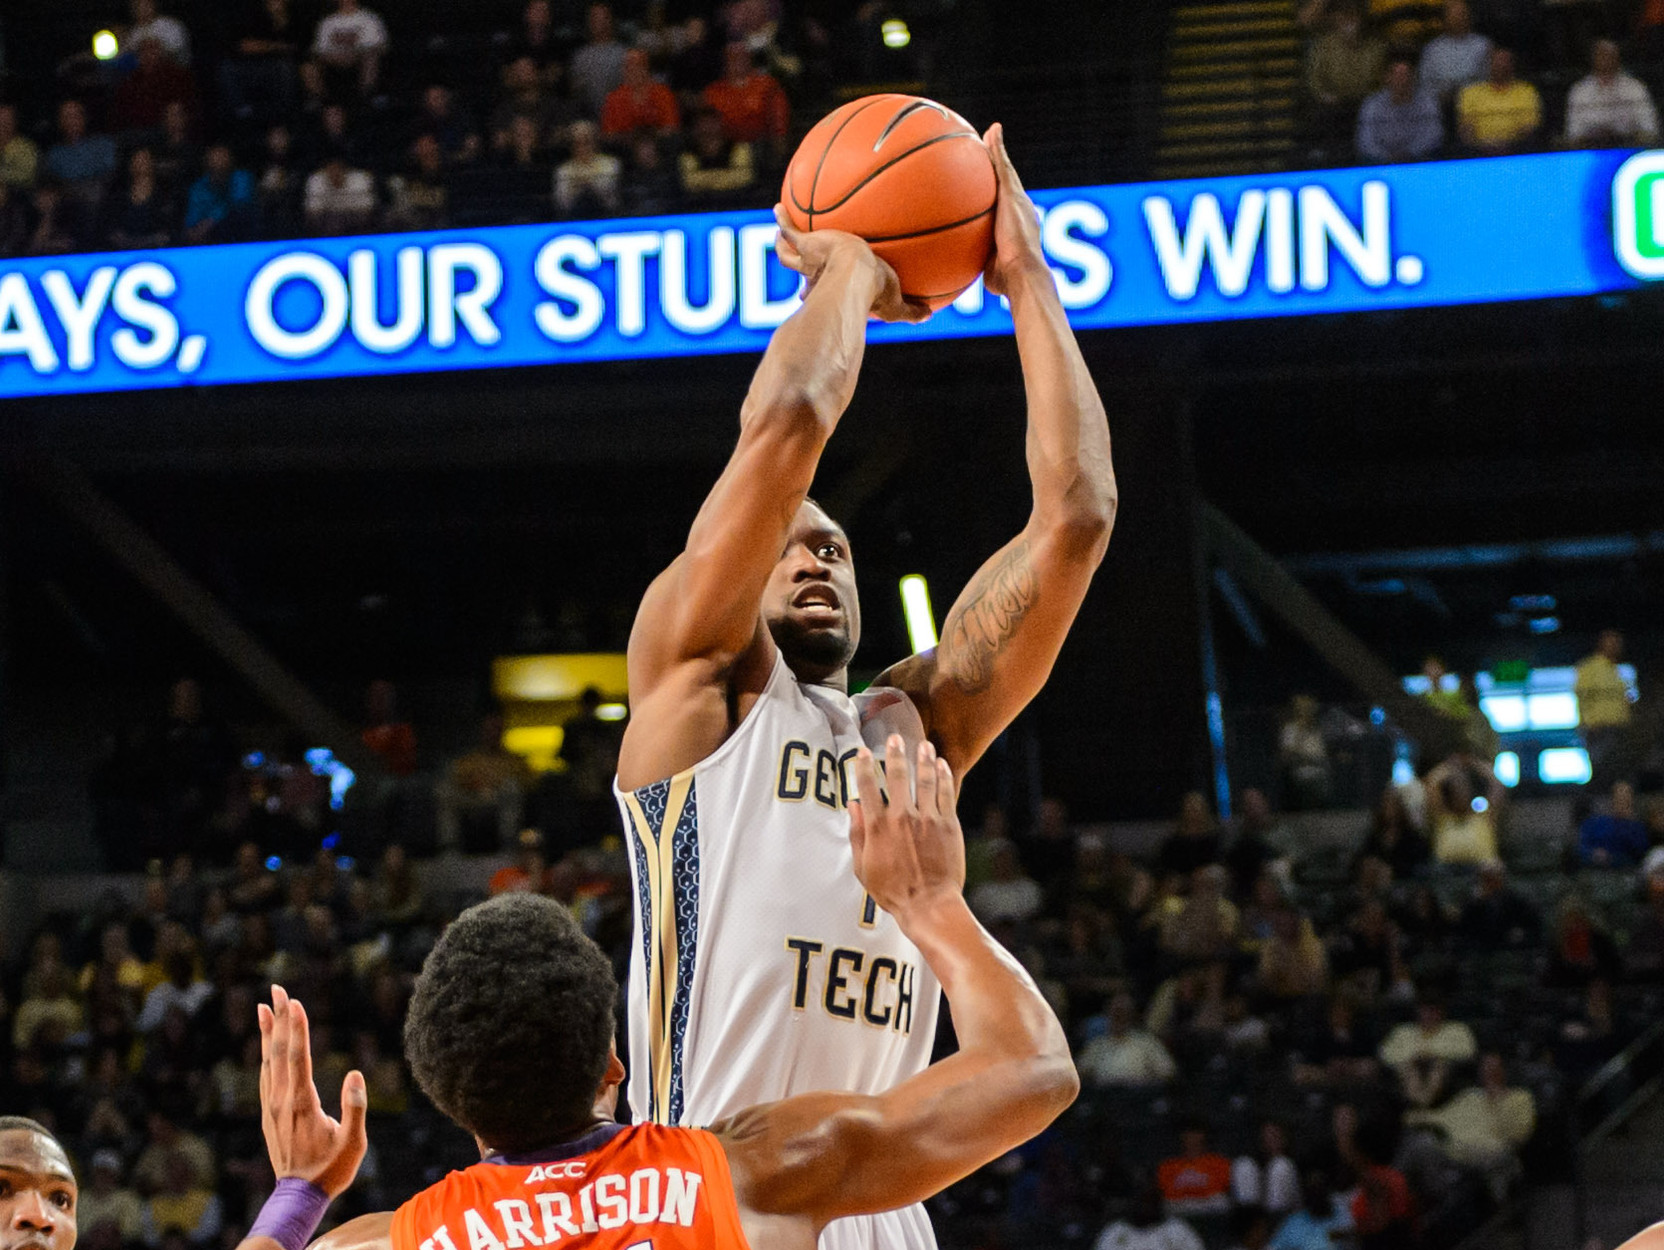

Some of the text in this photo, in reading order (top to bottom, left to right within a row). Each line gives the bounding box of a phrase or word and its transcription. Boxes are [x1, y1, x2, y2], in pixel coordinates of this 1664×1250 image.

[245, 243, 503, 361] OUR
[1143, 179, 1423, 301] WIN.
[784, 935, 915, 1035] TECH
[524, 1162, 587, 1184] ACC
